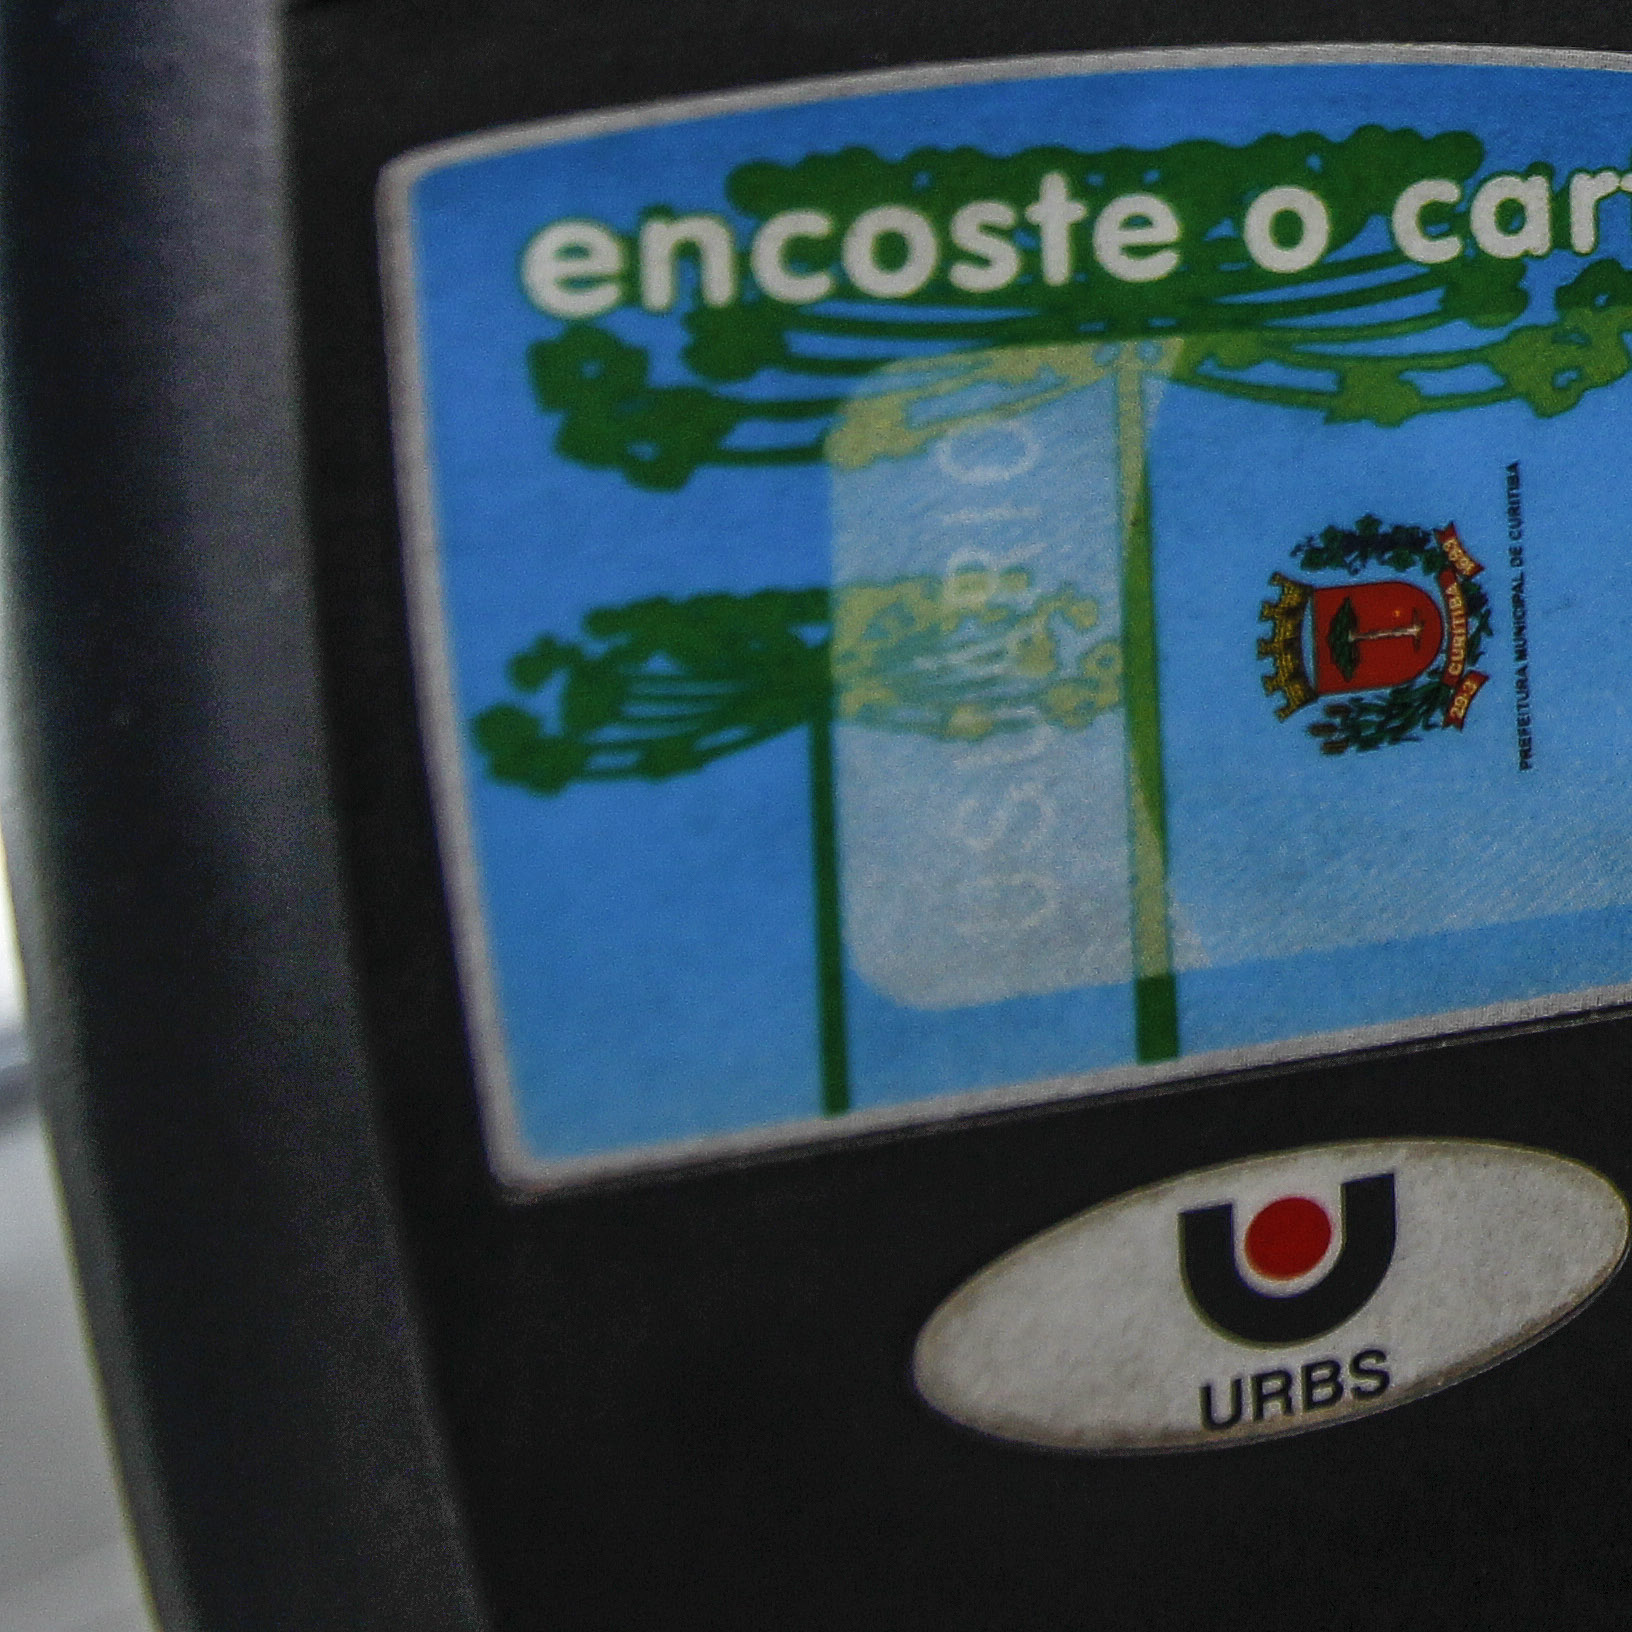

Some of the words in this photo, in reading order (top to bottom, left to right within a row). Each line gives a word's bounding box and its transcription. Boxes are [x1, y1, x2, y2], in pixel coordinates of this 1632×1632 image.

[523, 171, 1182, 318] encoste
[1248, 184, 1330, 272] o
[1506, 460, 1522, 542] CURITIBA
[1508, 546, 1524, 567] DE
[1446, 581, 1467, 676] CURITIBA
[1511, 571, 1527, 664] MUNICIPAL
[1515, 665, 1534, 770] PREFEITURA
[1200, 1348, 1392, 1432] URBS
